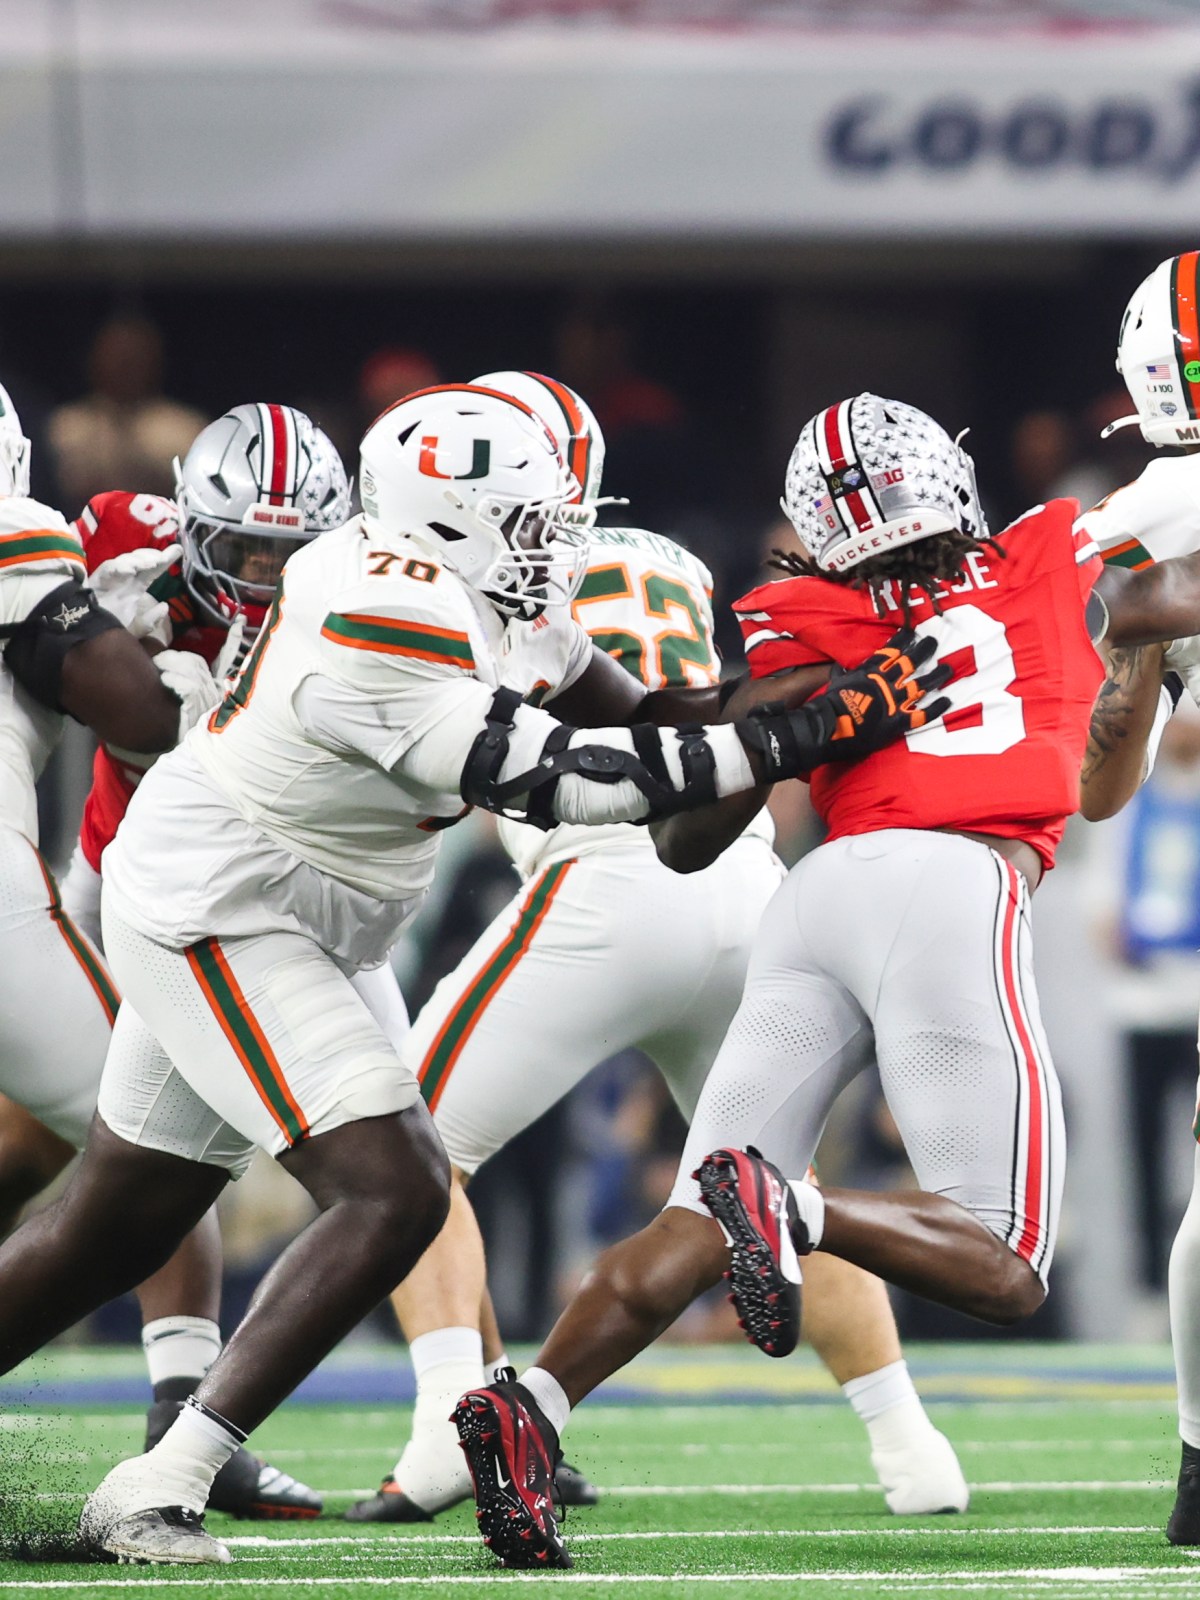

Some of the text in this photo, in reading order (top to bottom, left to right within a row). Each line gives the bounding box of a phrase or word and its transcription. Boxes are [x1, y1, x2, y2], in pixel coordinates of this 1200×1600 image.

[1158, 384, 1173, 393] 100
[418, 436, 491, 480] U
[825, 514, 836, 529] 8
[366, 551, 441, 585] 70
[827, 522, 922, 571] BUCKEYES
[568, 561, 722, 690] 52
[904, 604, 1027, 757] 8
